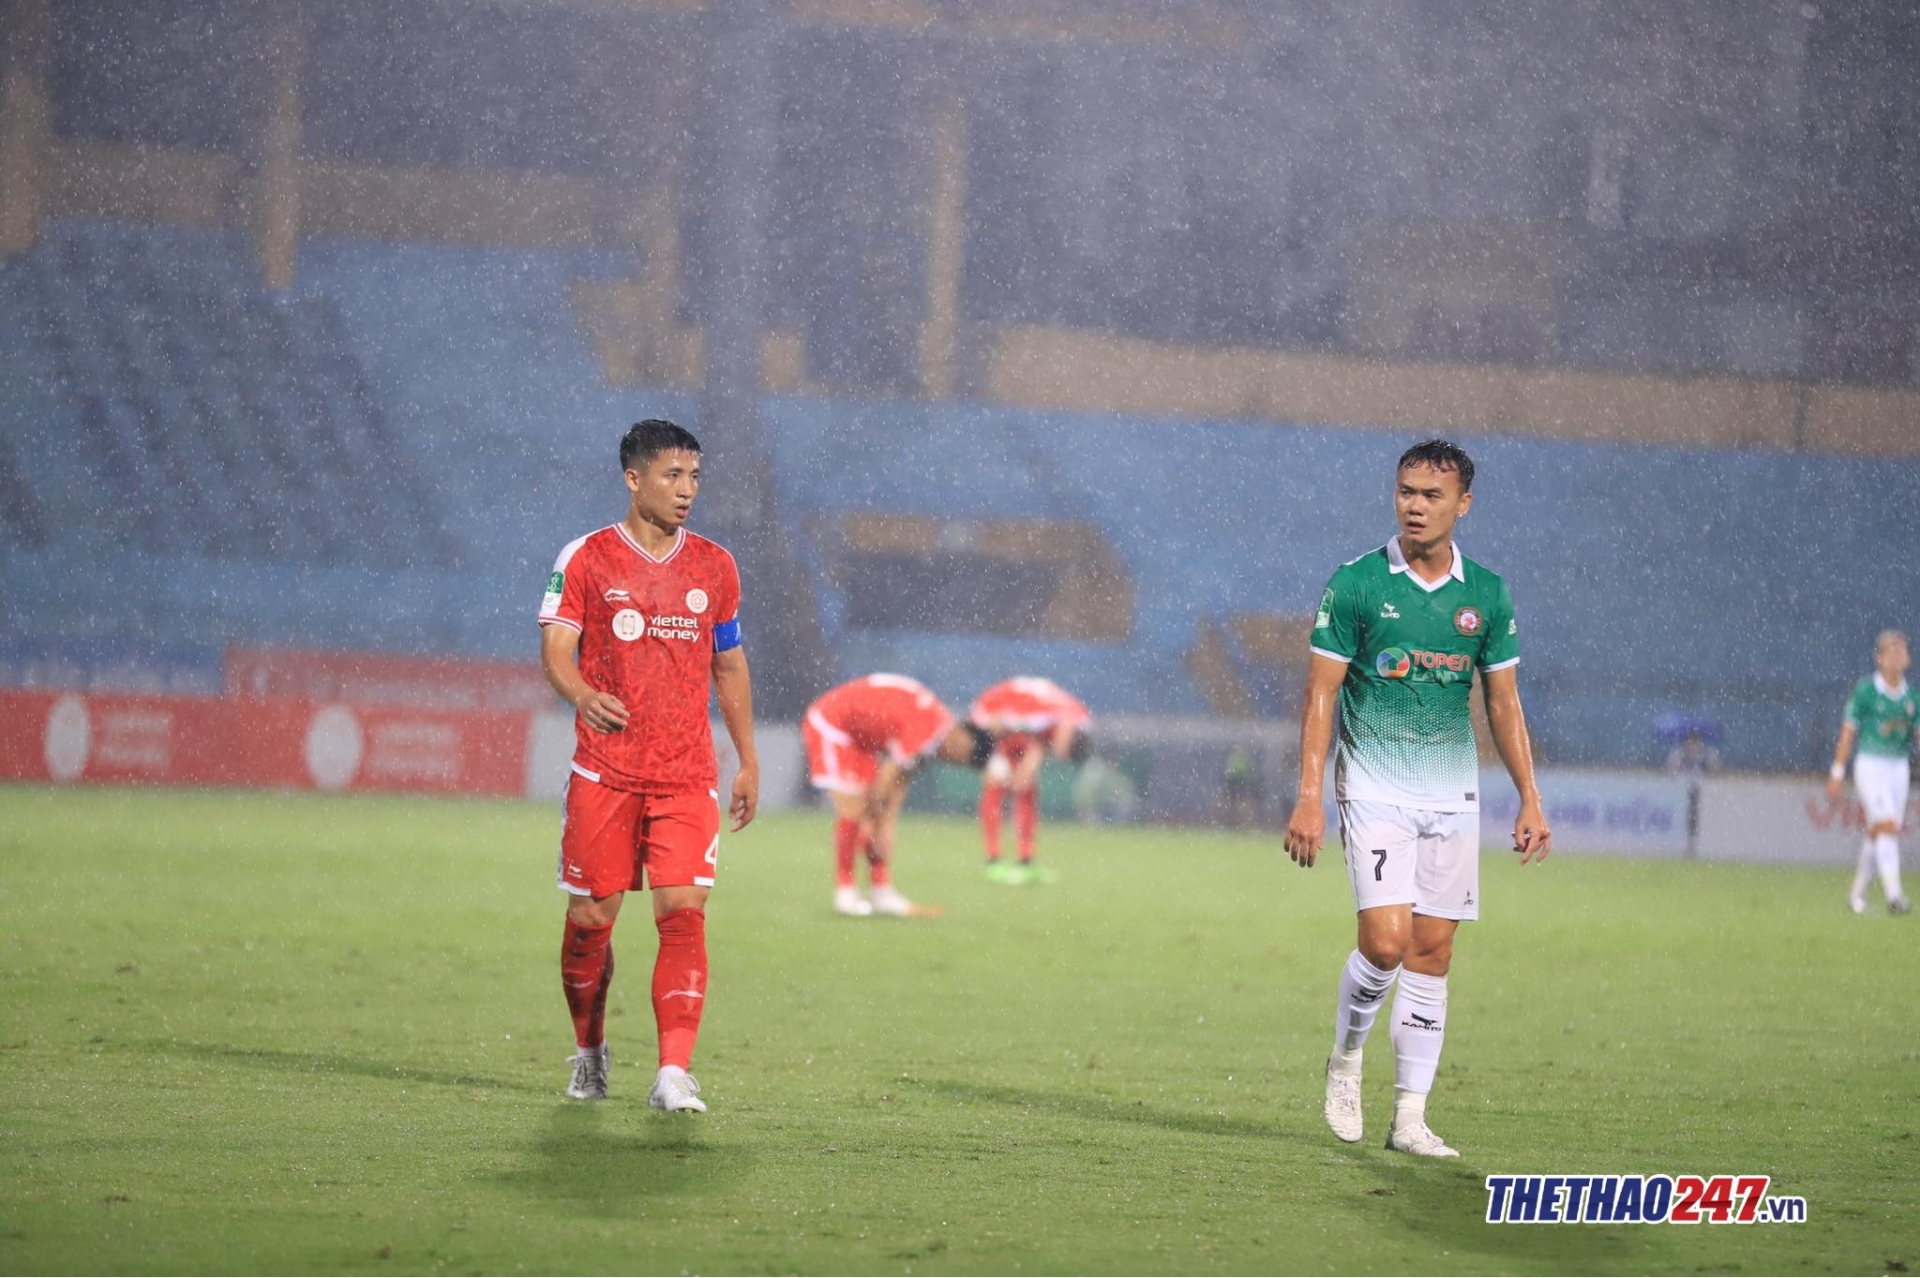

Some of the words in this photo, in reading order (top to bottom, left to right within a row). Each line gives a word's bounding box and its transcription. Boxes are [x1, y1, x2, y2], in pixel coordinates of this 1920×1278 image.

[649, 614, 699, 629] viettel
[647, 626, 700, 643] money
[1410, 649, 1471, 672] TOPEN
[704, 832, 720, 875] 4
[1371, 849, 1388, 882] 7
